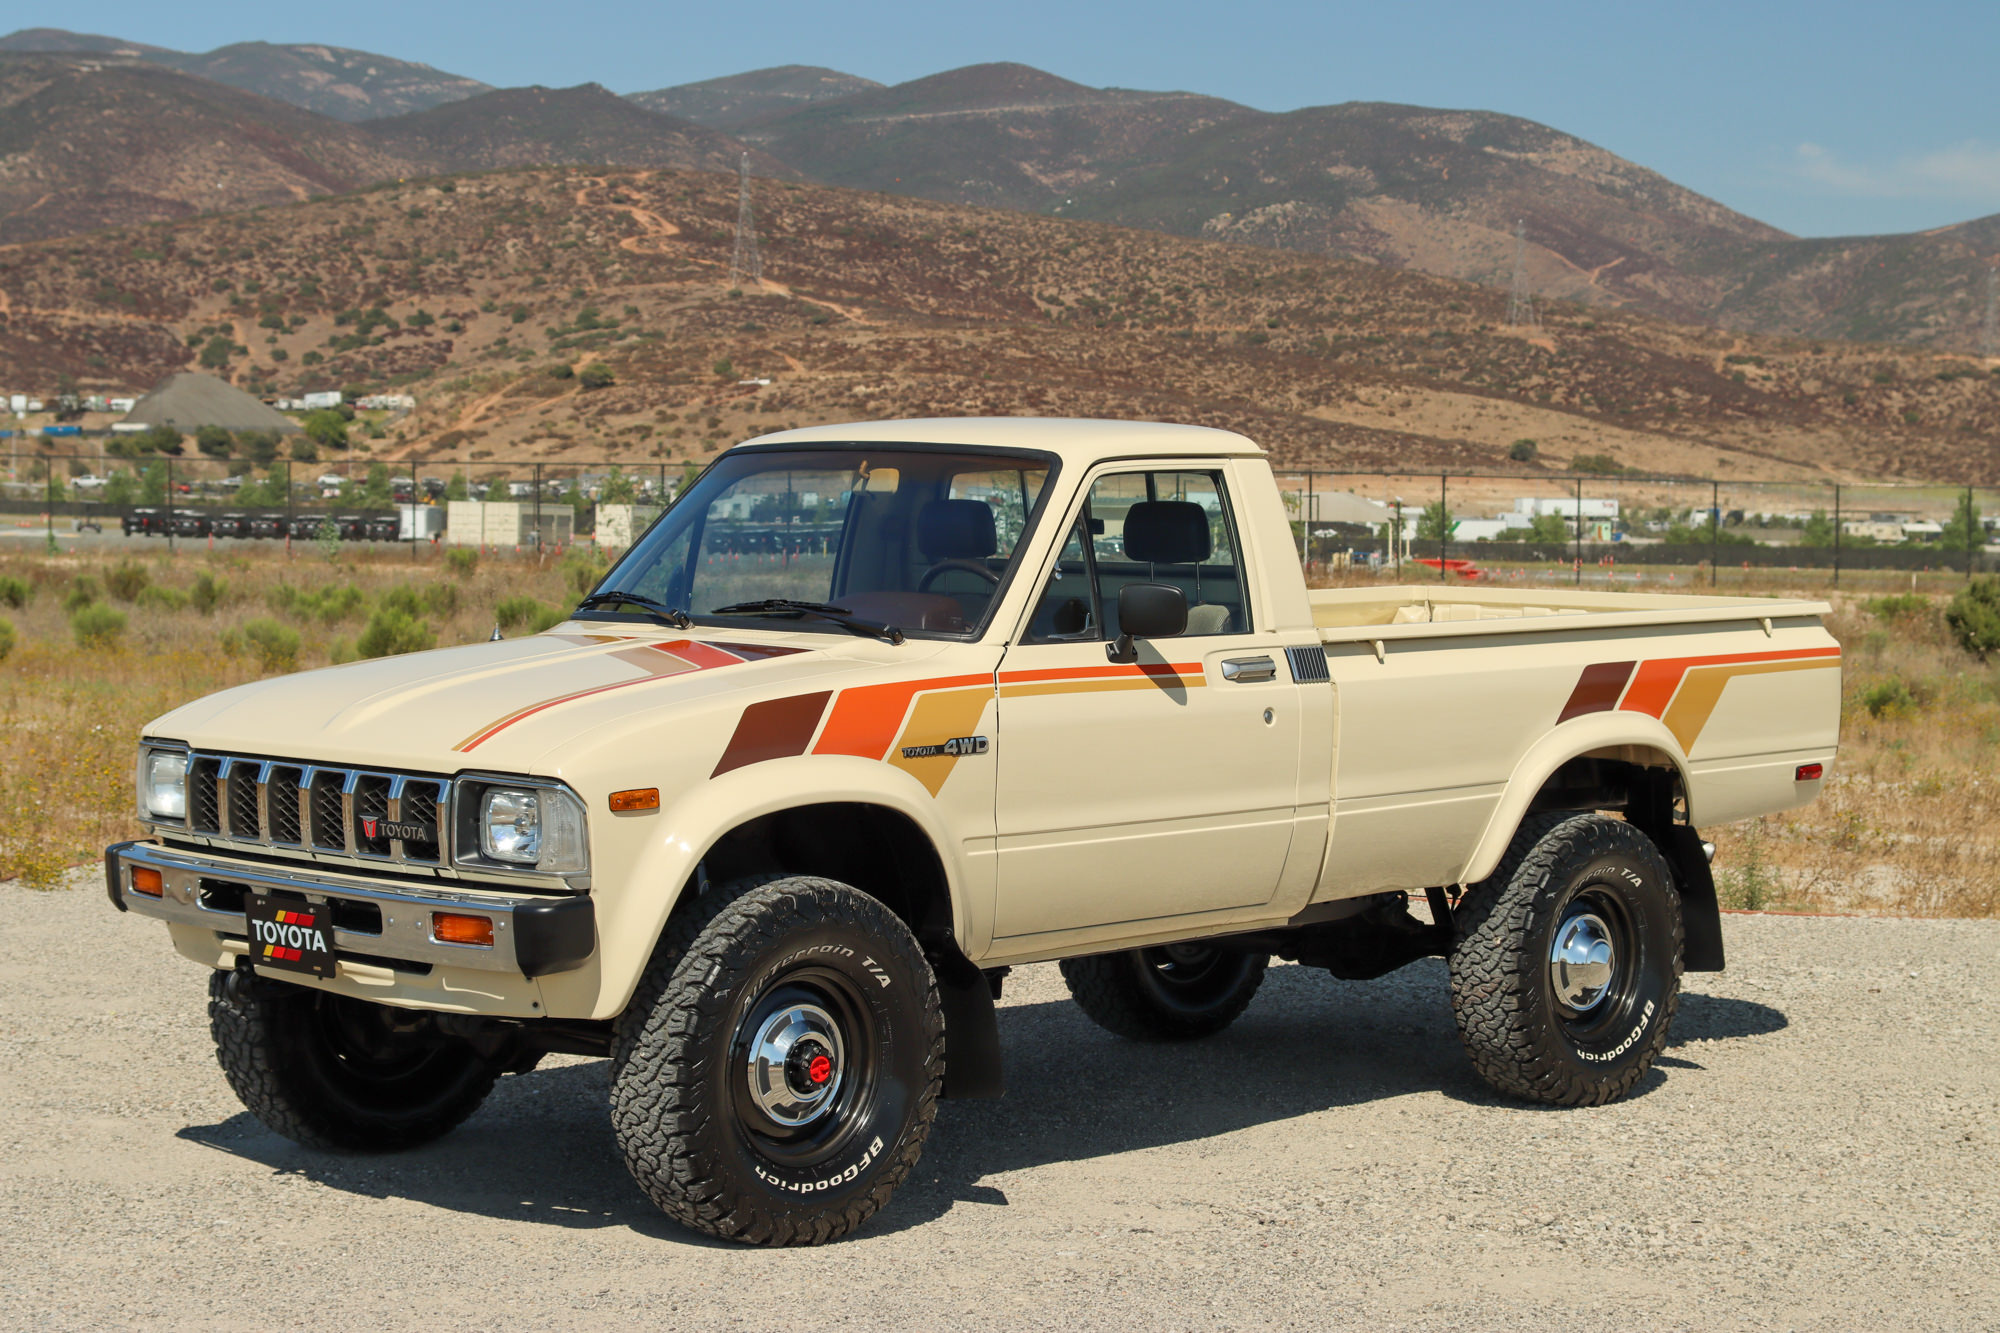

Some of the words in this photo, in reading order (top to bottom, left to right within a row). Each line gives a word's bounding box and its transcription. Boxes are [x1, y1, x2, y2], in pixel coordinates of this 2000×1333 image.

[902, 747, 937, 757] TOYOTA
[944, 736, 989, 754] 4WD
[380, 823, 426, 841] TOYOTA
[1620, 867, 1643, 888] T/A
[252, 919, 327, 953] TOYOTA
[861, 955, 892, 989] T/A
[1576, 999, 1655, 1063] BFGoodrich
[754, 1135, 884, 1194] BFGoodrich
